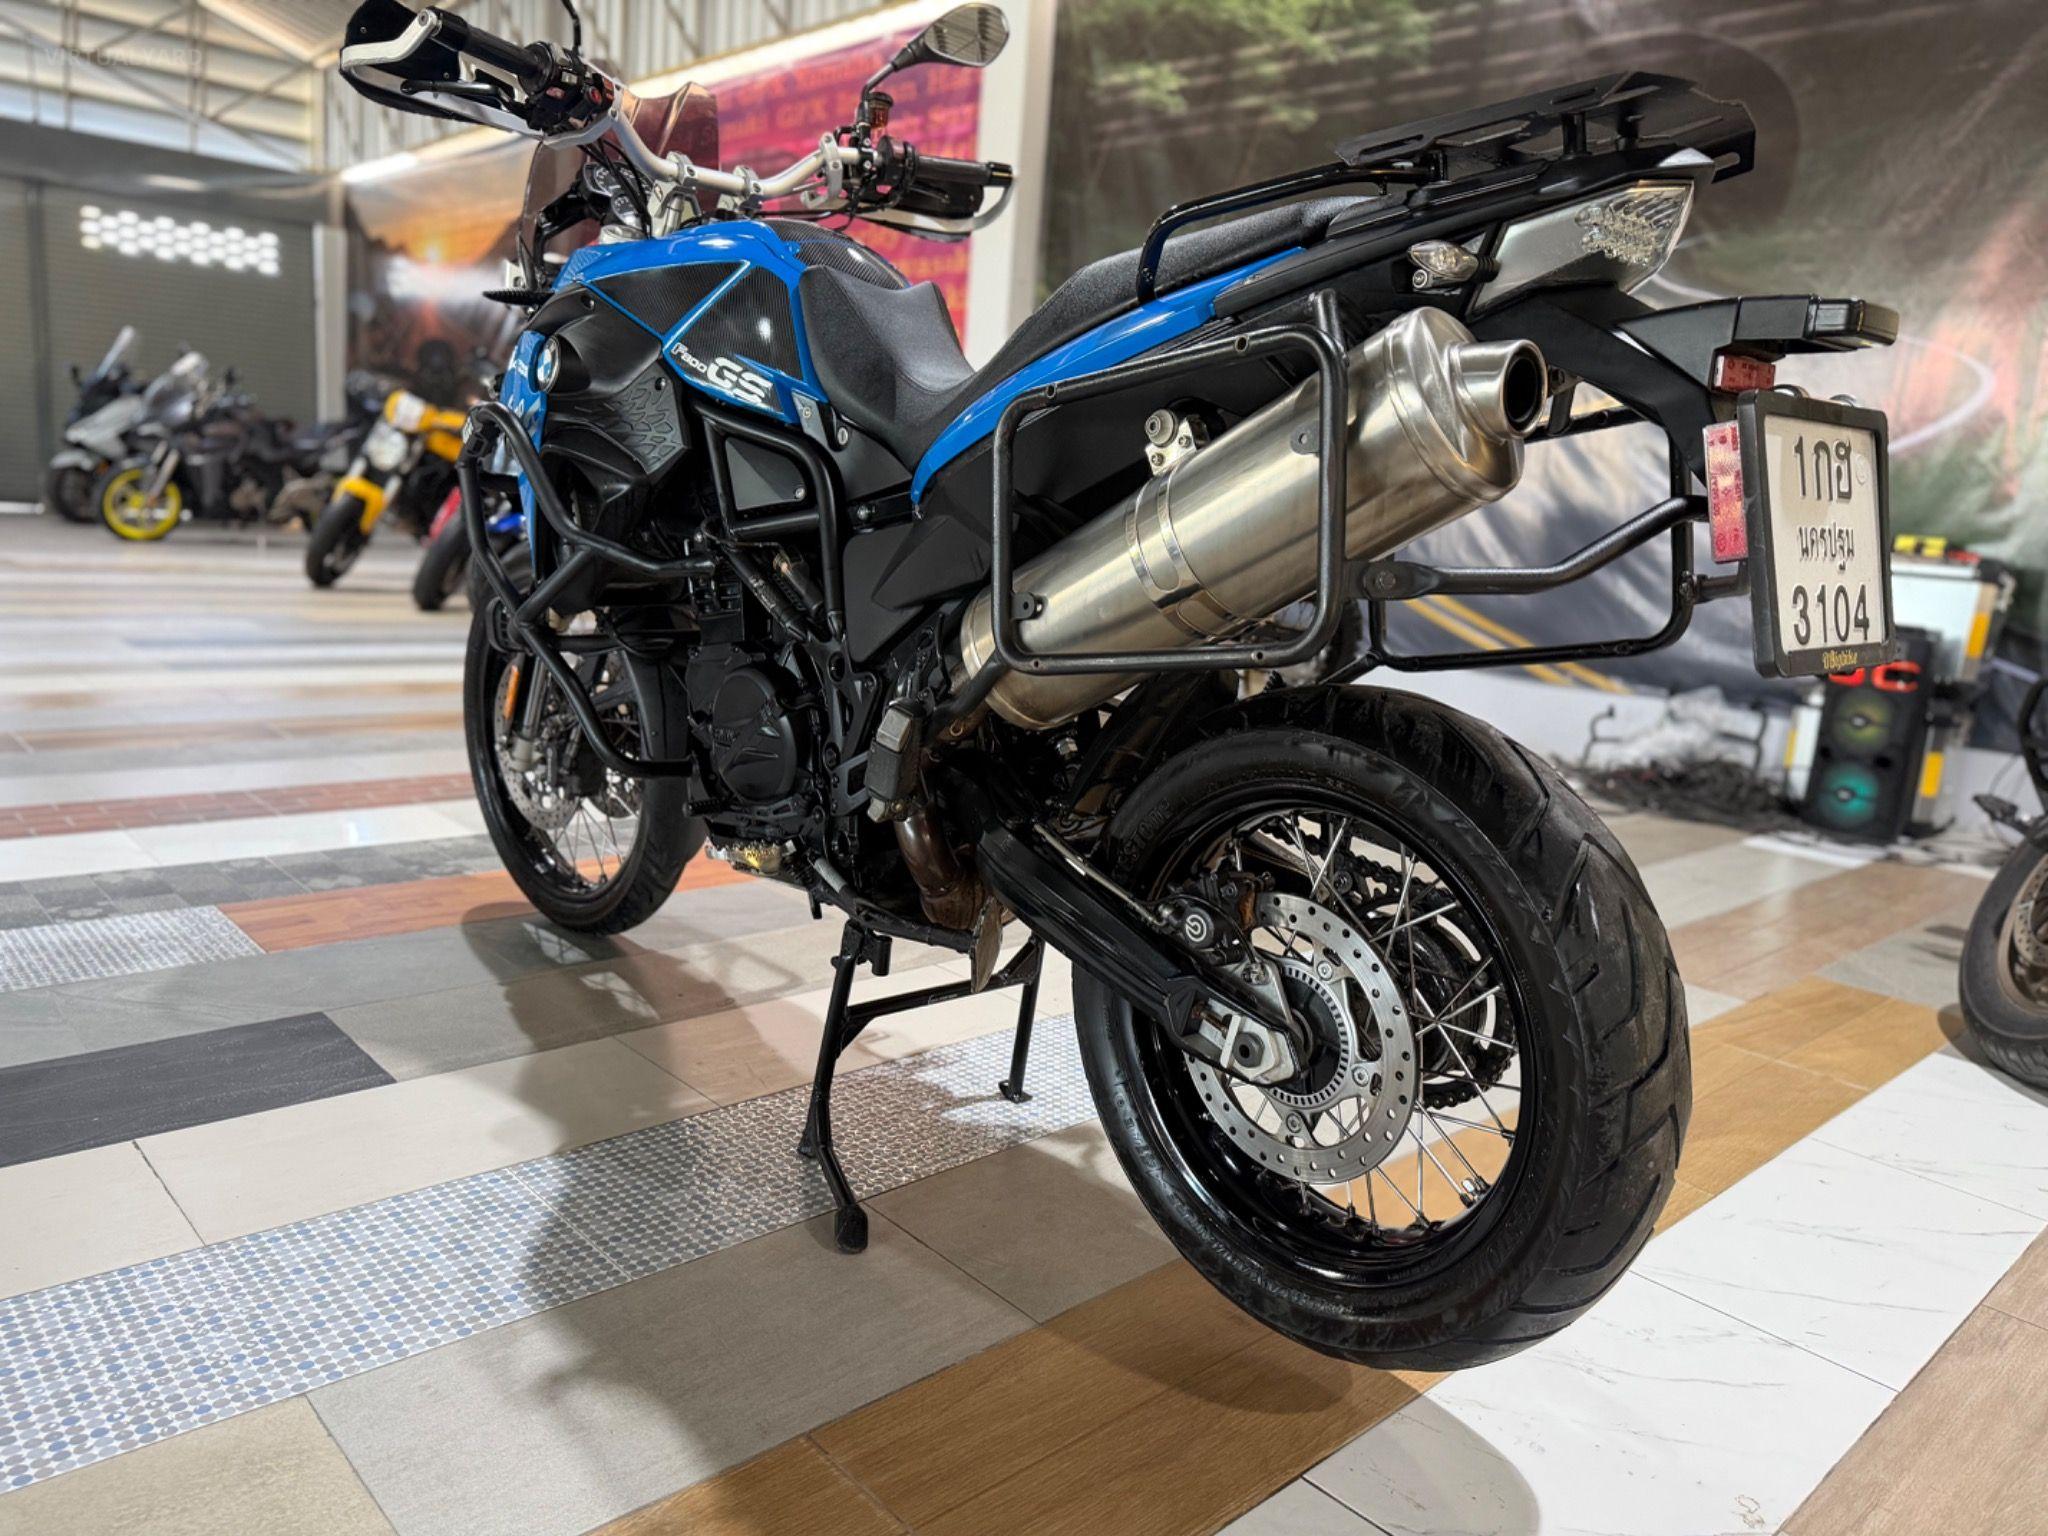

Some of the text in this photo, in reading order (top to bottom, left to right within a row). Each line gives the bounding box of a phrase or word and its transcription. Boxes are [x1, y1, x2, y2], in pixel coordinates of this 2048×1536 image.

[706, 356, 774, 404] GS
[1798, 521, 1855, 571] นครปฐม
[1792, 584, 1870, 645] 3104
